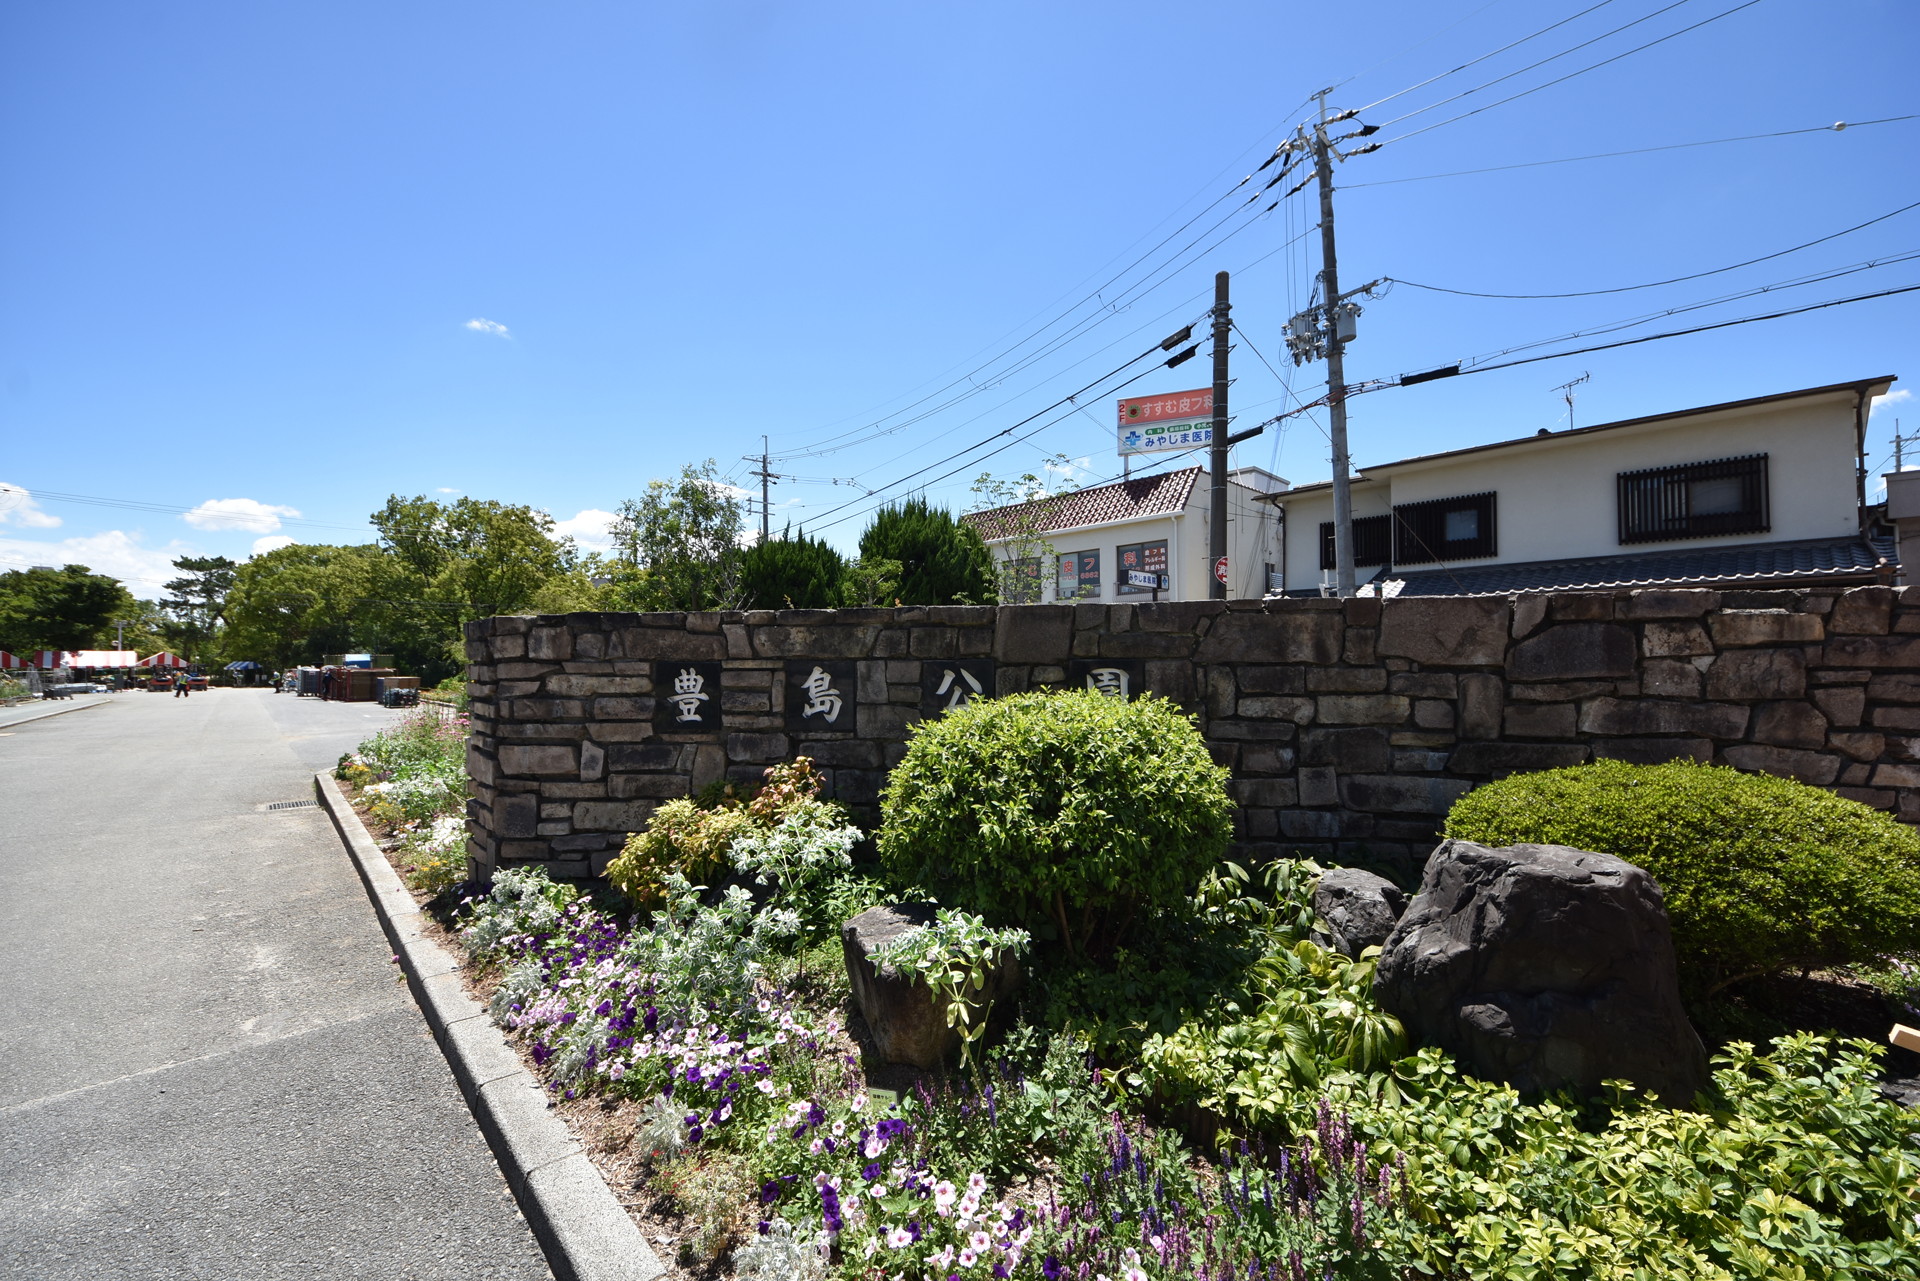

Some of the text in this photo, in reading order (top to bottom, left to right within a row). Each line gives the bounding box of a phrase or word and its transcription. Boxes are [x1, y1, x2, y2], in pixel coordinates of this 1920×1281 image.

[1145, 430, 1212, 447] みやじま医院
